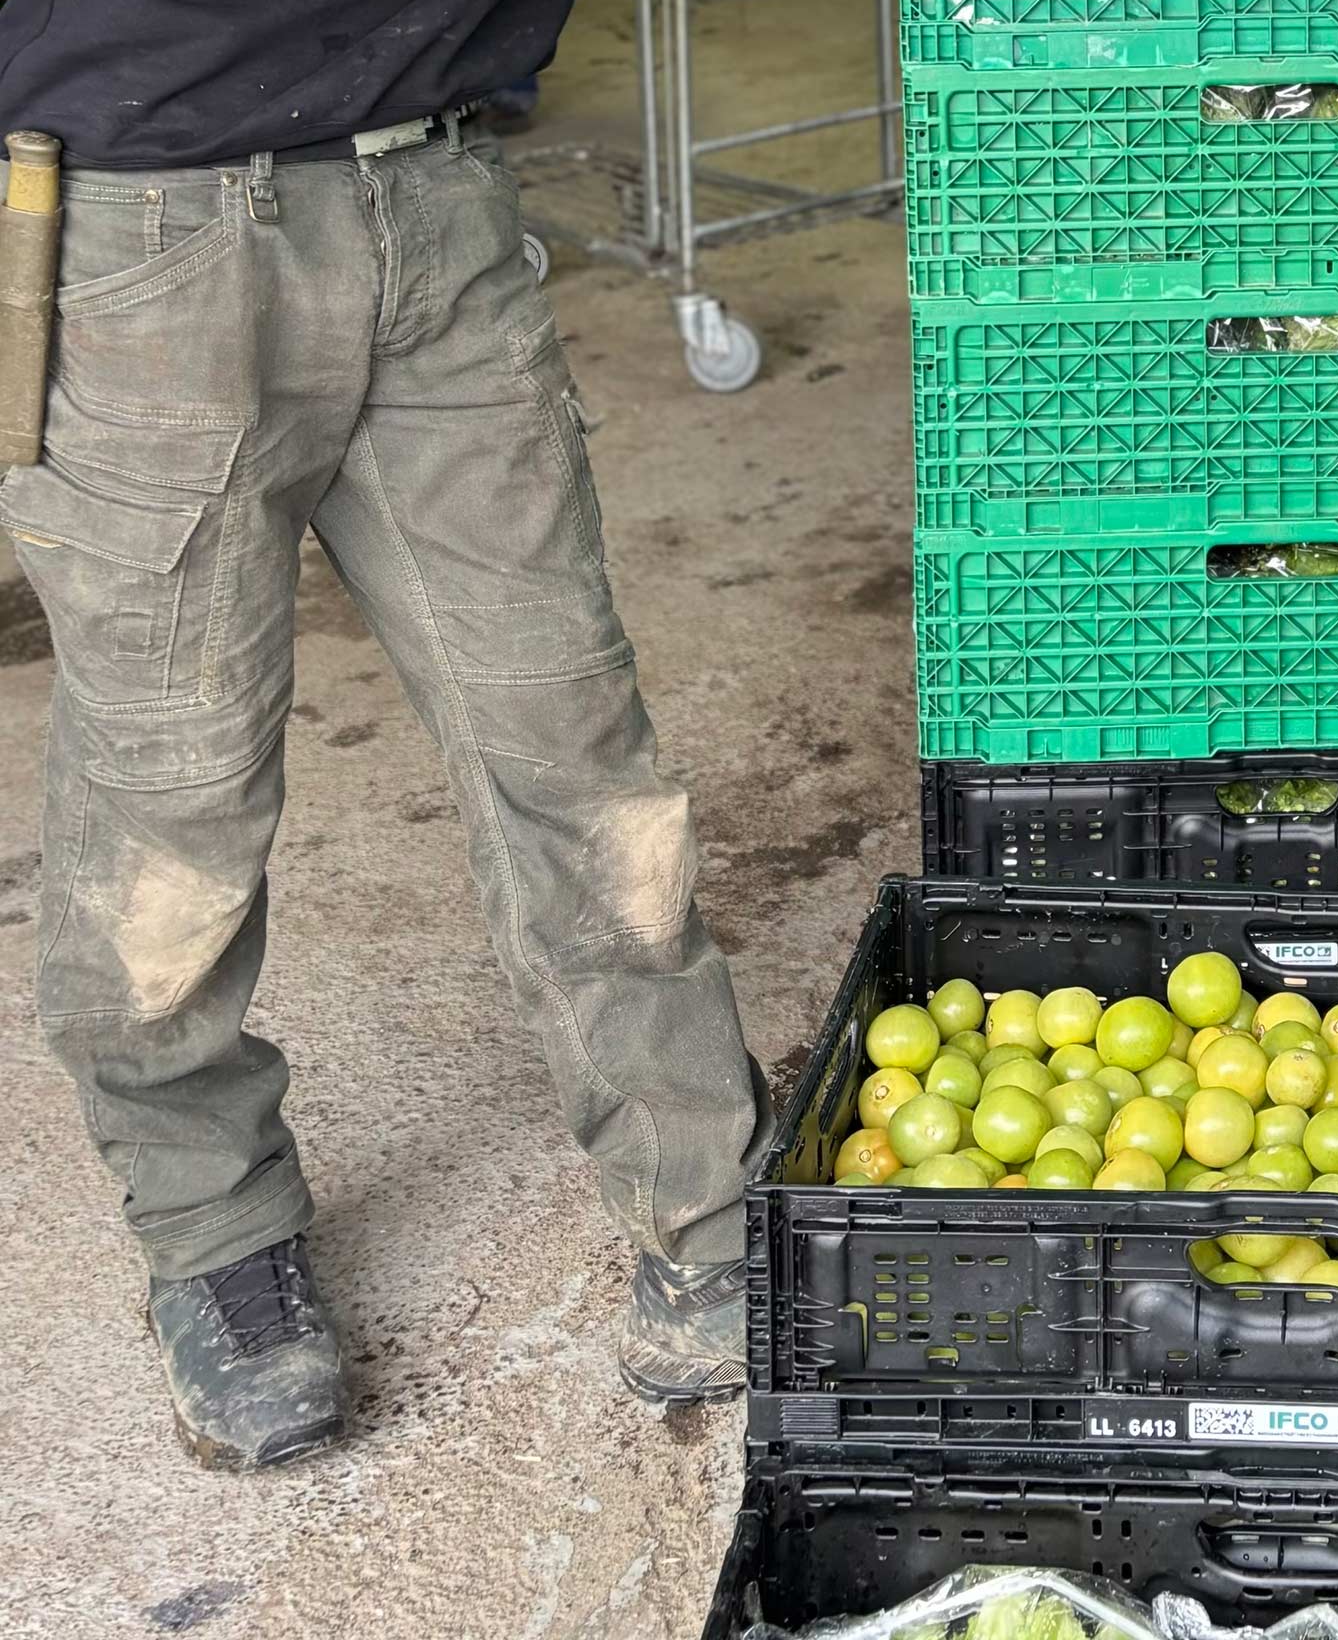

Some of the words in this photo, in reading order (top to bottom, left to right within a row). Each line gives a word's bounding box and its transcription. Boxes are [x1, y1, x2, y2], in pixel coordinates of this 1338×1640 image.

[1275, 945, 1316, 958] IFCO
[1090, 1417, 1114, 1436] LL
[1128, 1418, 1177, 1438] 6413
[1268, 1411, 1329, 1430] IFCO
